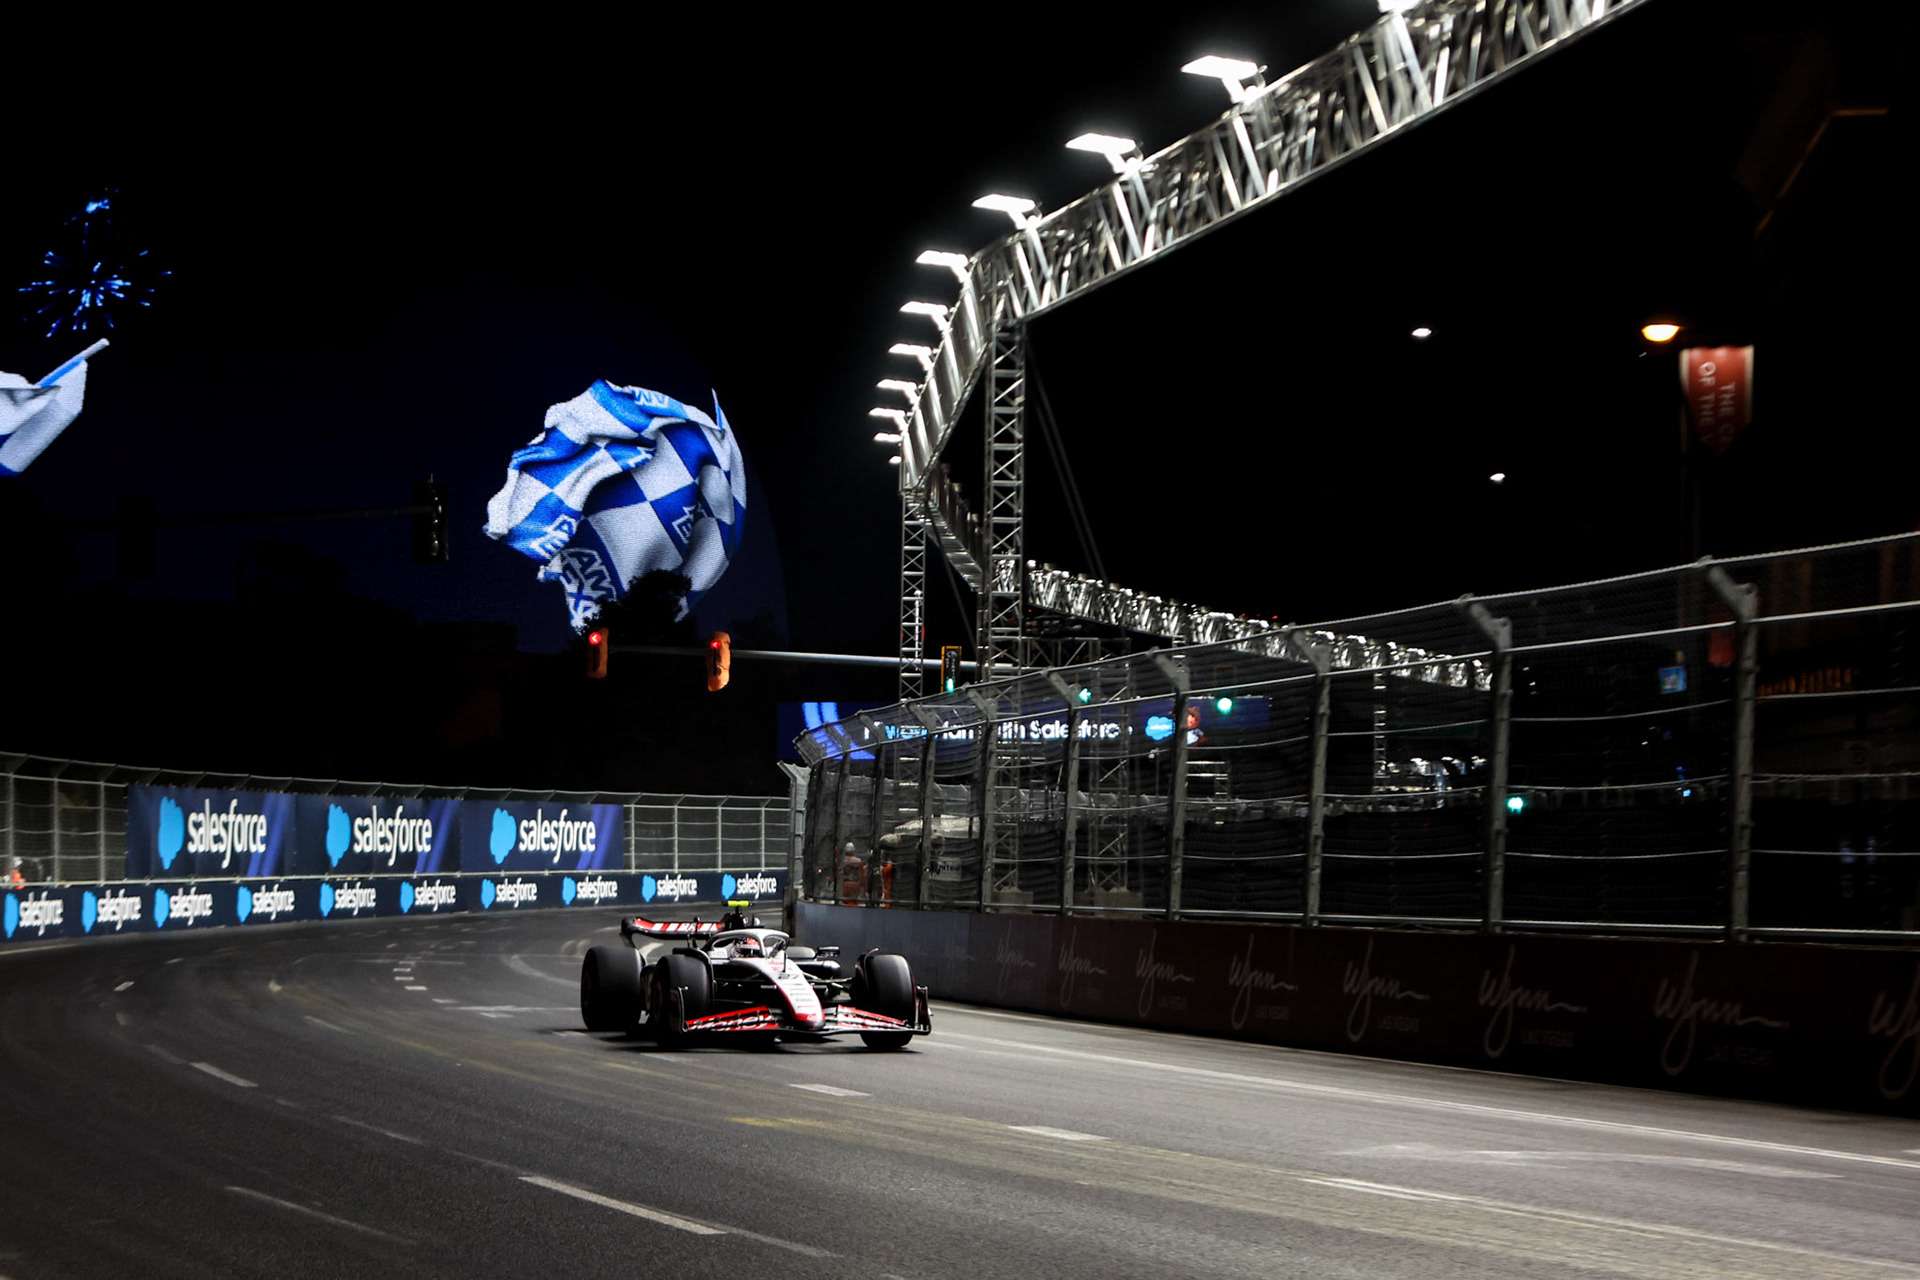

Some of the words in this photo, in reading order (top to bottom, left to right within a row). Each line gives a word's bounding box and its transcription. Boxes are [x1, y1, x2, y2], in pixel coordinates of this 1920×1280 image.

[1698, 361, 1716, 388] OF
[187, 798, 267, 869] salesforce
[353, 805, 433, 867] salesforce
[518, 809, 597, 863] salesforce
[252, 884, 295, 921] salesforce
[334, 882, 377, 916] salesforce
[414, 879, 457, 912] salesforce
[495, 877, 538, 910] salesforce
[576, 875, 618, 905] salesforce
[656, 873, 698, 902] salesforce
[736, 873, 778, 902] salesforce
[19, 891, 64, 936] salesforce
[97, 888, 142, 931] salesforce
[169, 886, 213, 926] salesforce
